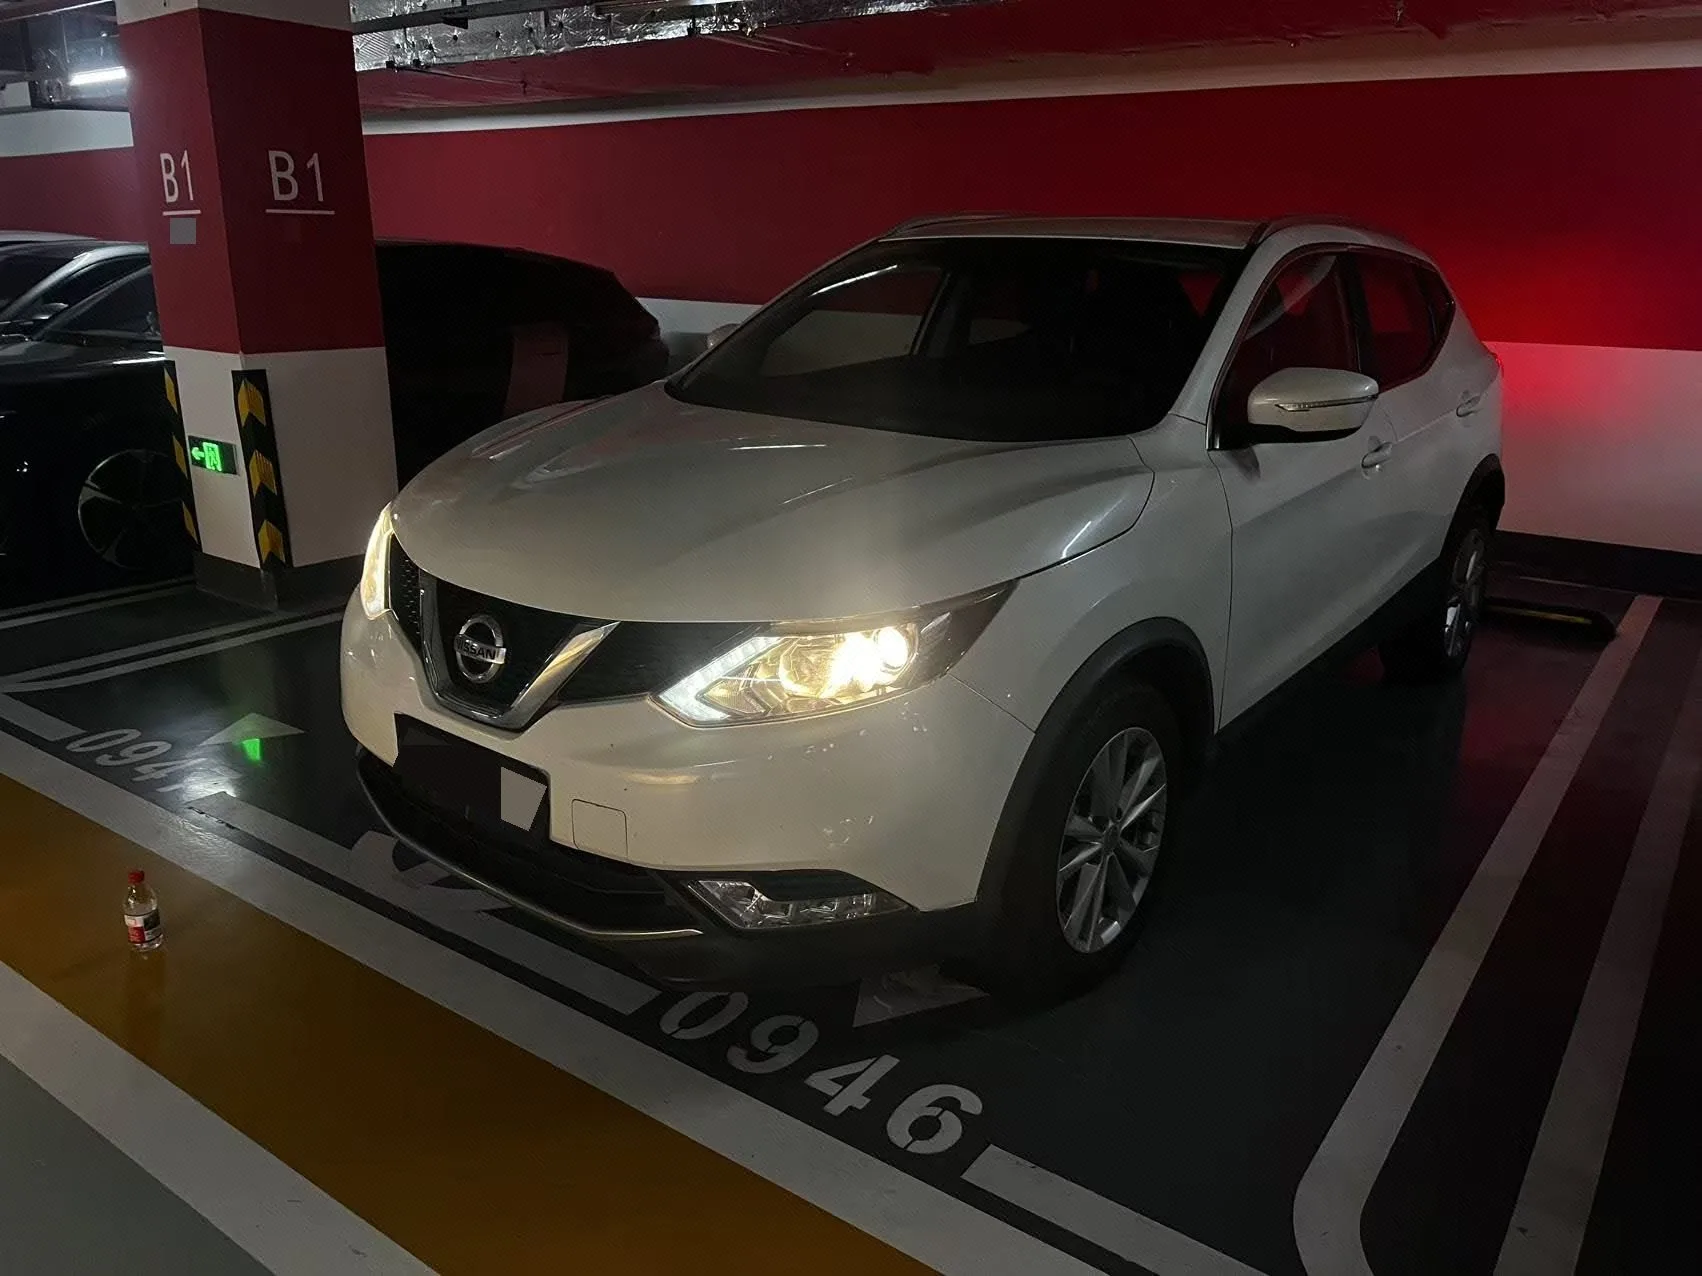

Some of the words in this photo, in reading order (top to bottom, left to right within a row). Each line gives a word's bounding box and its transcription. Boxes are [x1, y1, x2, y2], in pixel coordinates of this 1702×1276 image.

[160, 149, 194, 203] B1
[268, 150, 323, 202] B1
[455, 637, 496, 660] NISSAN
[658, 991, 983, 1155] 0946
